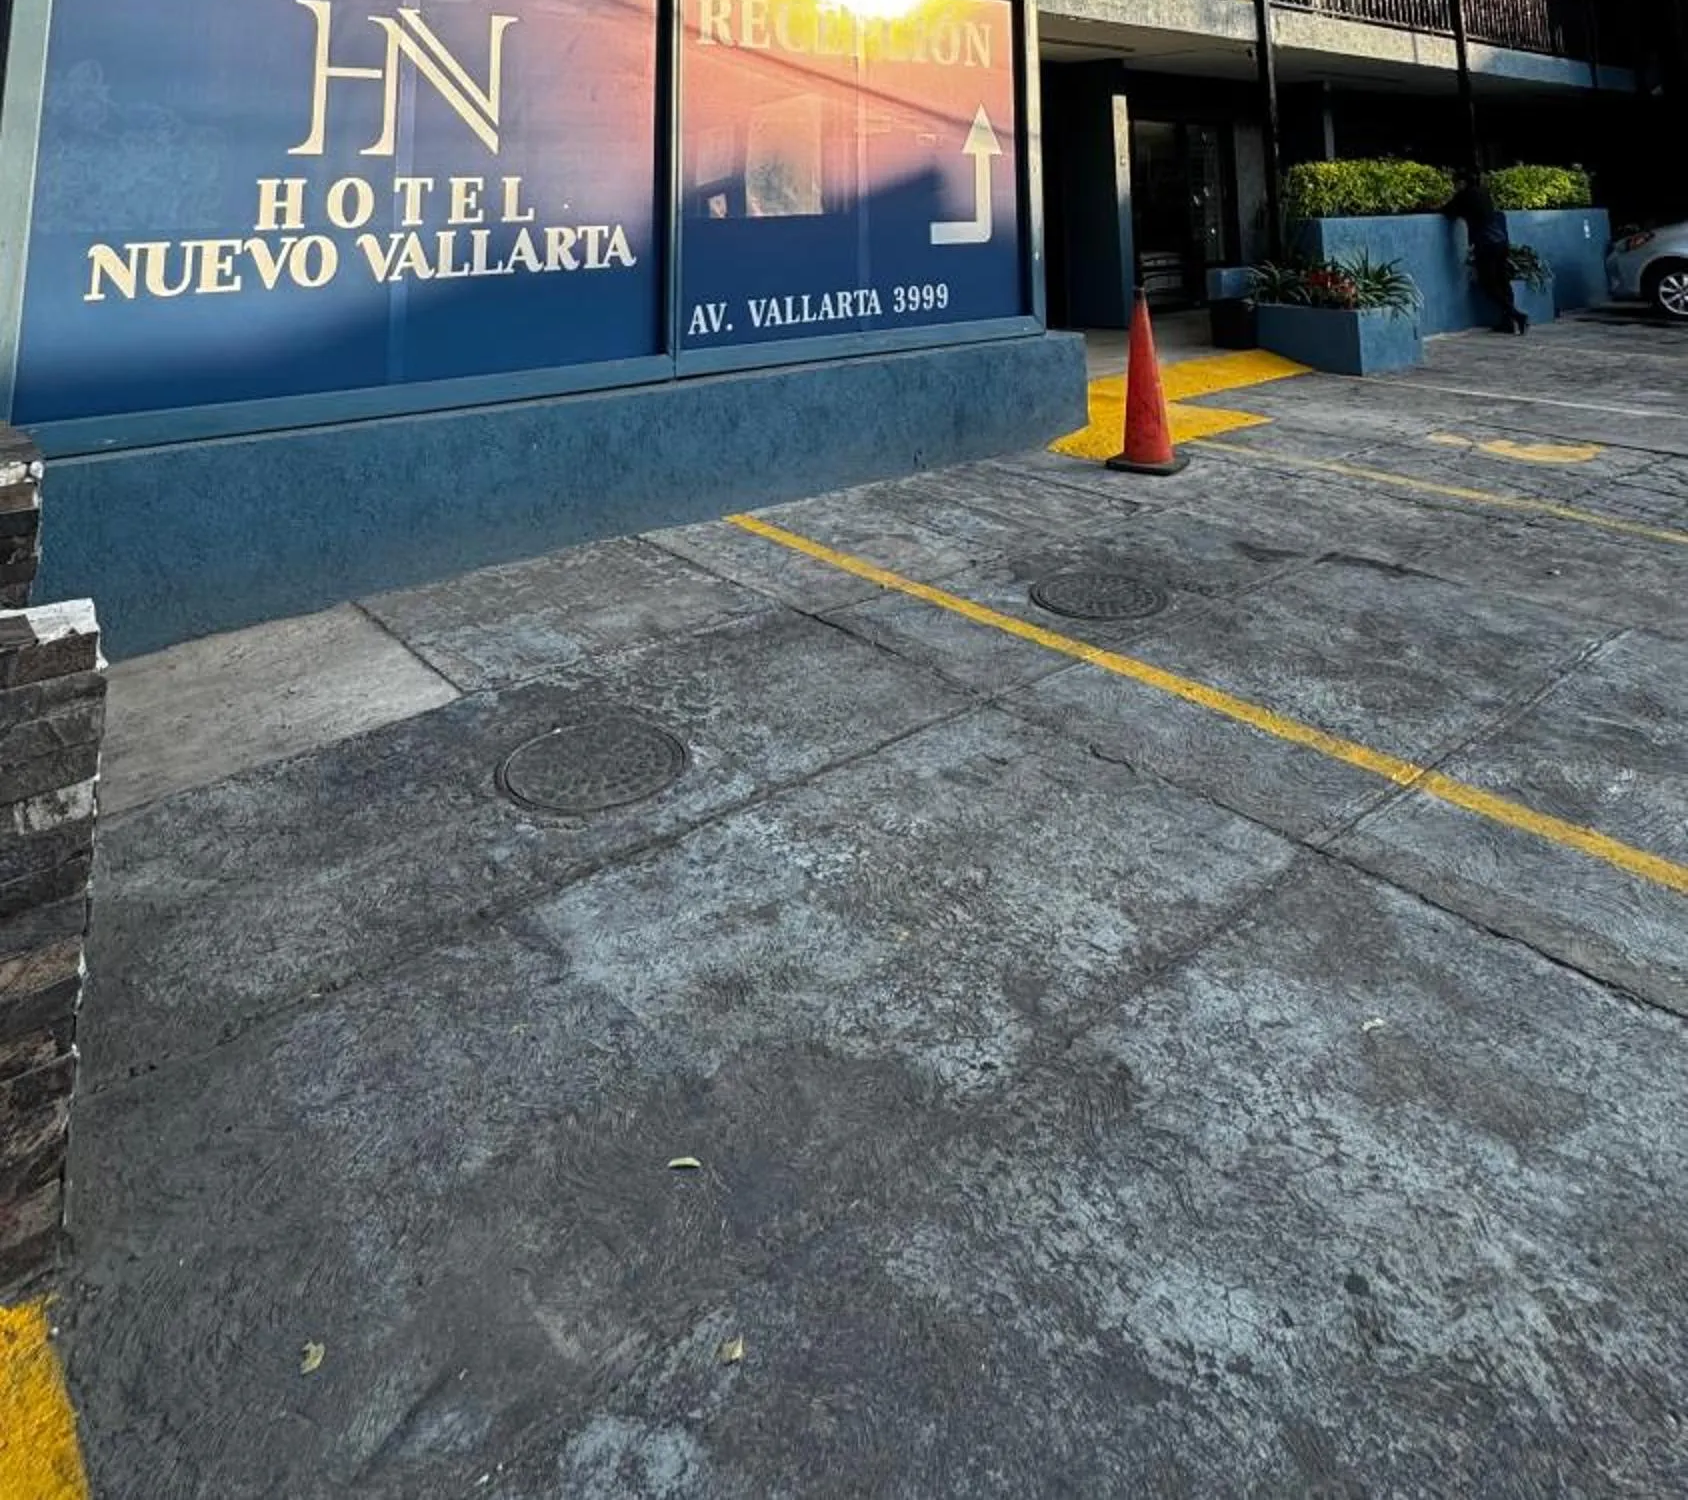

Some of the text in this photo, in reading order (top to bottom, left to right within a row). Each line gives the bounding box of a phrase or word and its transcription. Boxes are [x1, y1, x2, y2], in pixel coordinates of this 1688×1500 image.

[254, 177, 536, 231] HOTEL
[84, 223, 637, 302] NUEVO VALLARTA
[688, 283, 950, 335] AV. VALLARTA 3999
